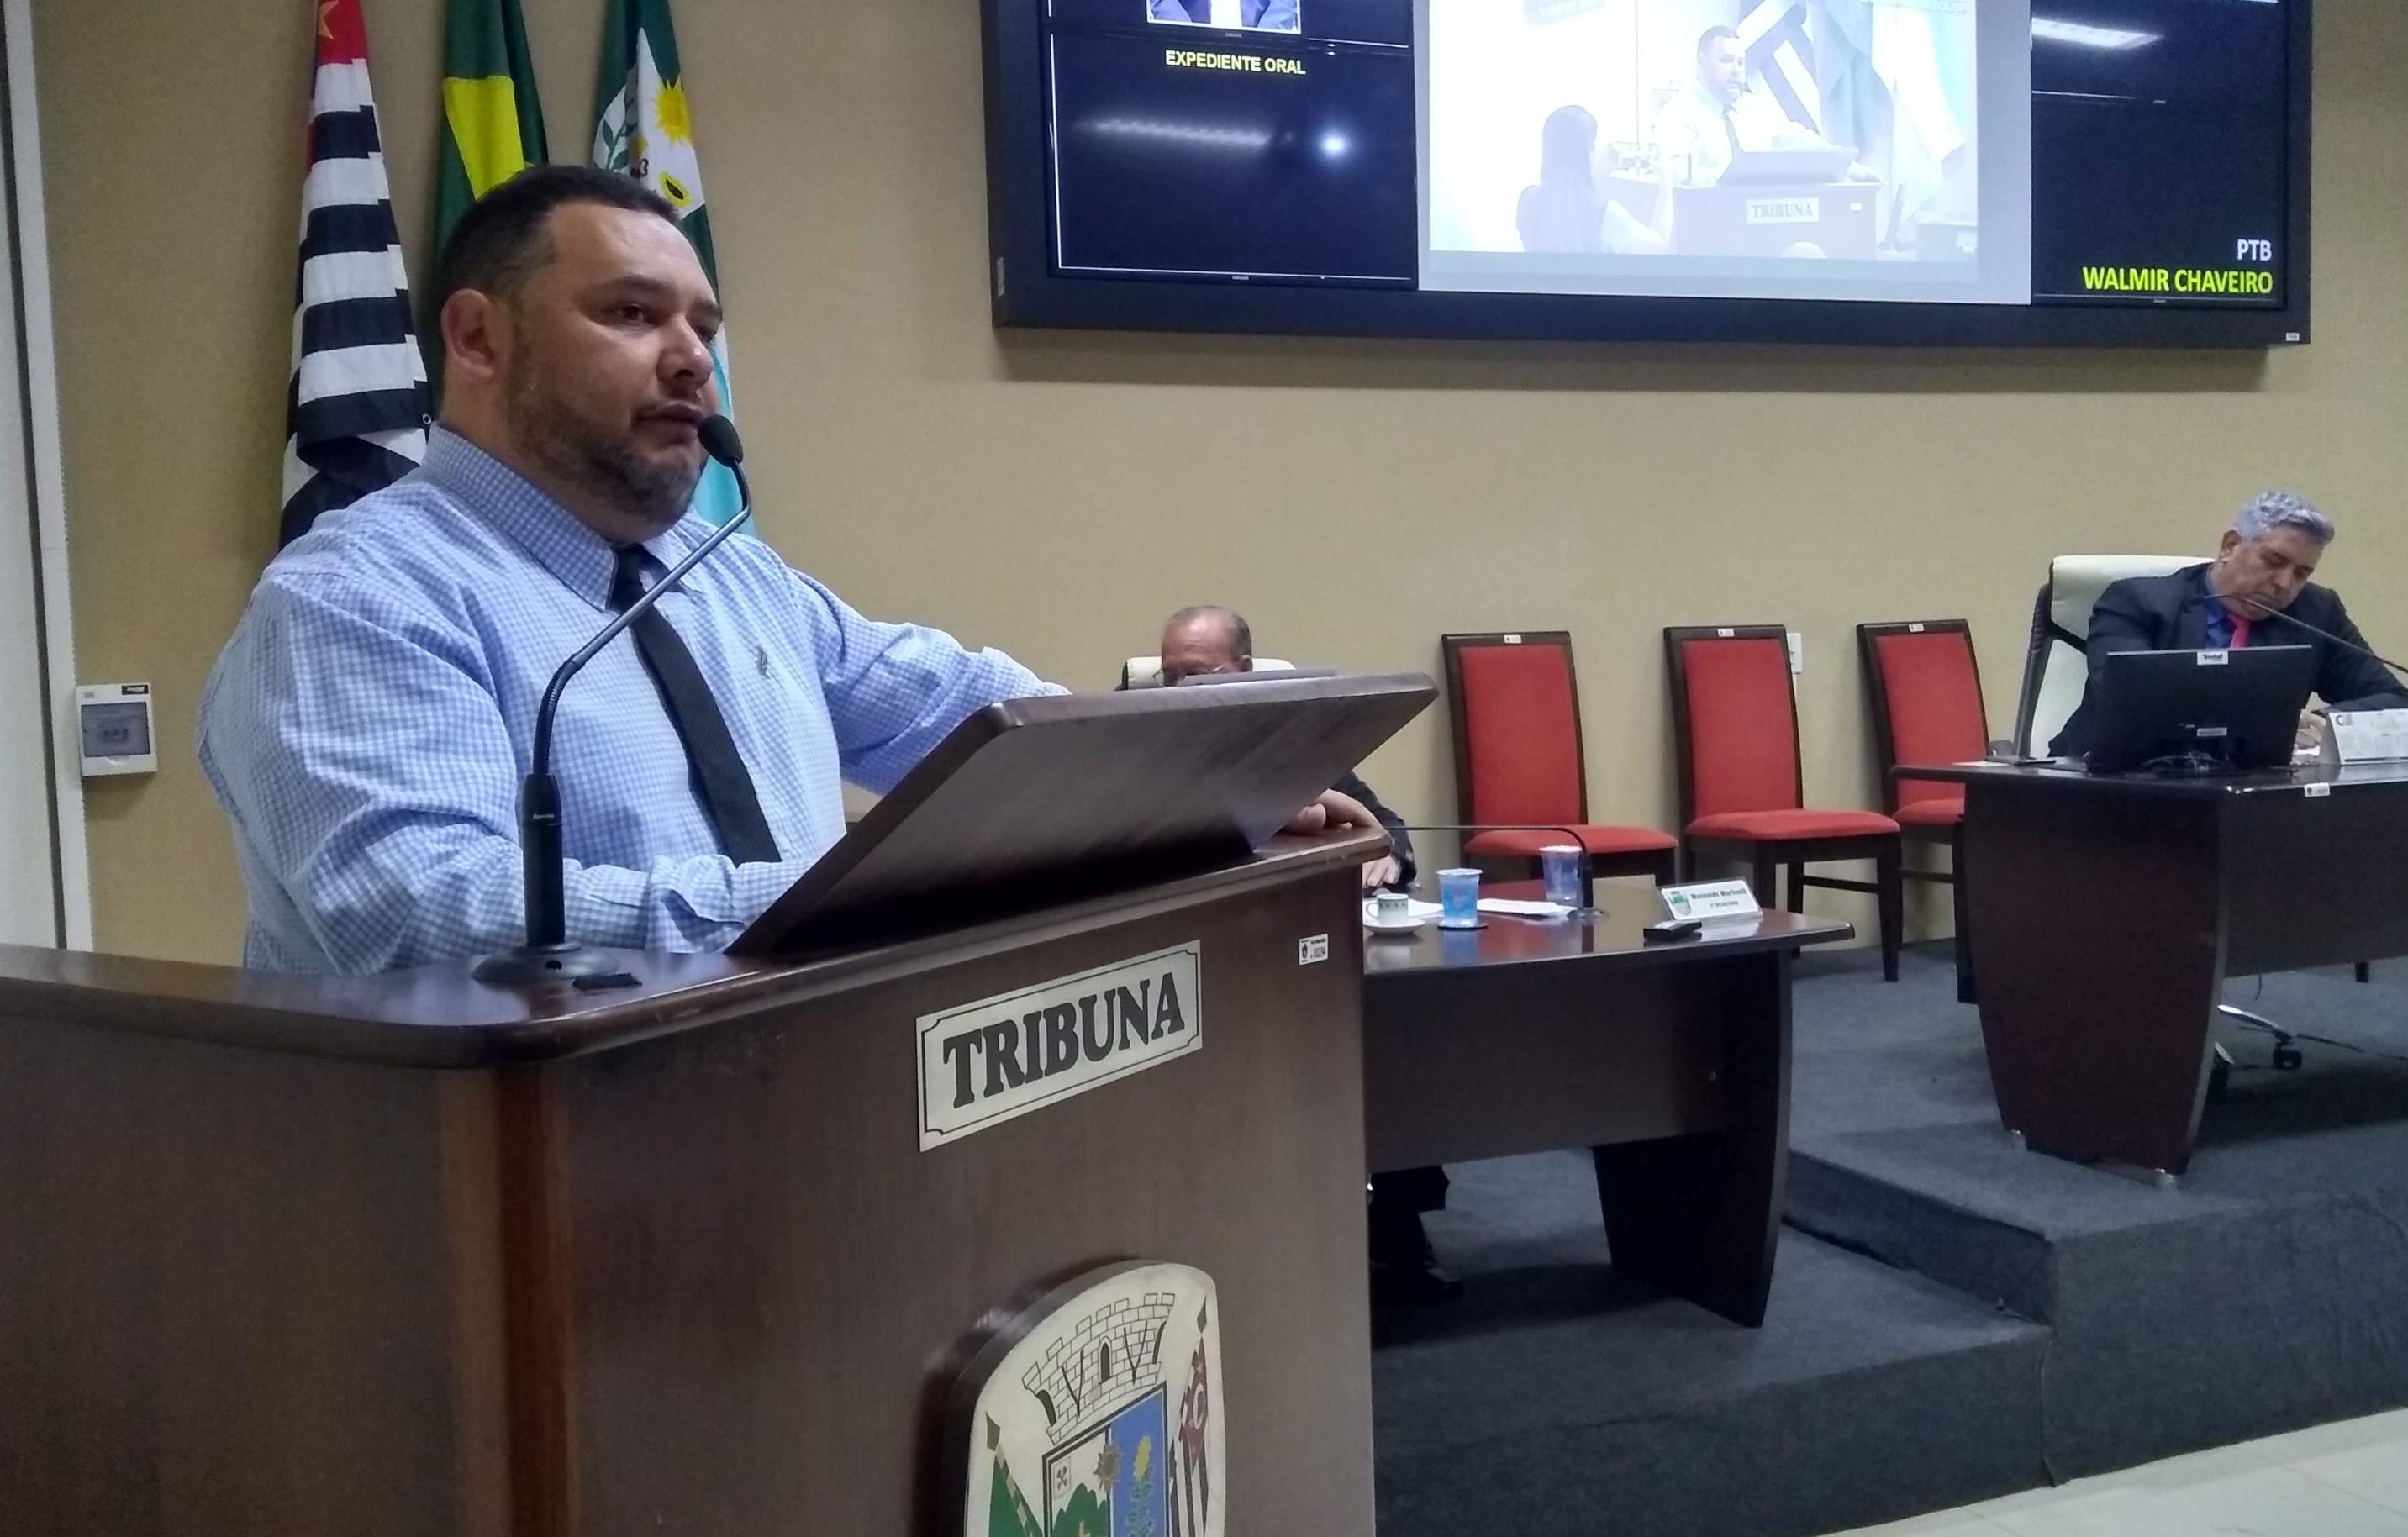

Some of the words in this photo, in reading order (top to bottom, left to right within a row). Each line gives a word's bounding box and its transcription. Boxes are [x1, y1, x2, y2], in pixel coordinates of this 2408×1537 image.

[1165, 50, 1262, 71] EXPEDIENTE
[1264, 58, 1306, 75] ORAL
[1752, 203, 1813, 218] TRIBUNA
[2237, 239, 2273, 261] PTB
[2082, 266, 2170, 292] WALMIR
[2174, 269, 2274, 294] CHAVEIRO
[943, 972, 1185, 1108] TRIBUNA
